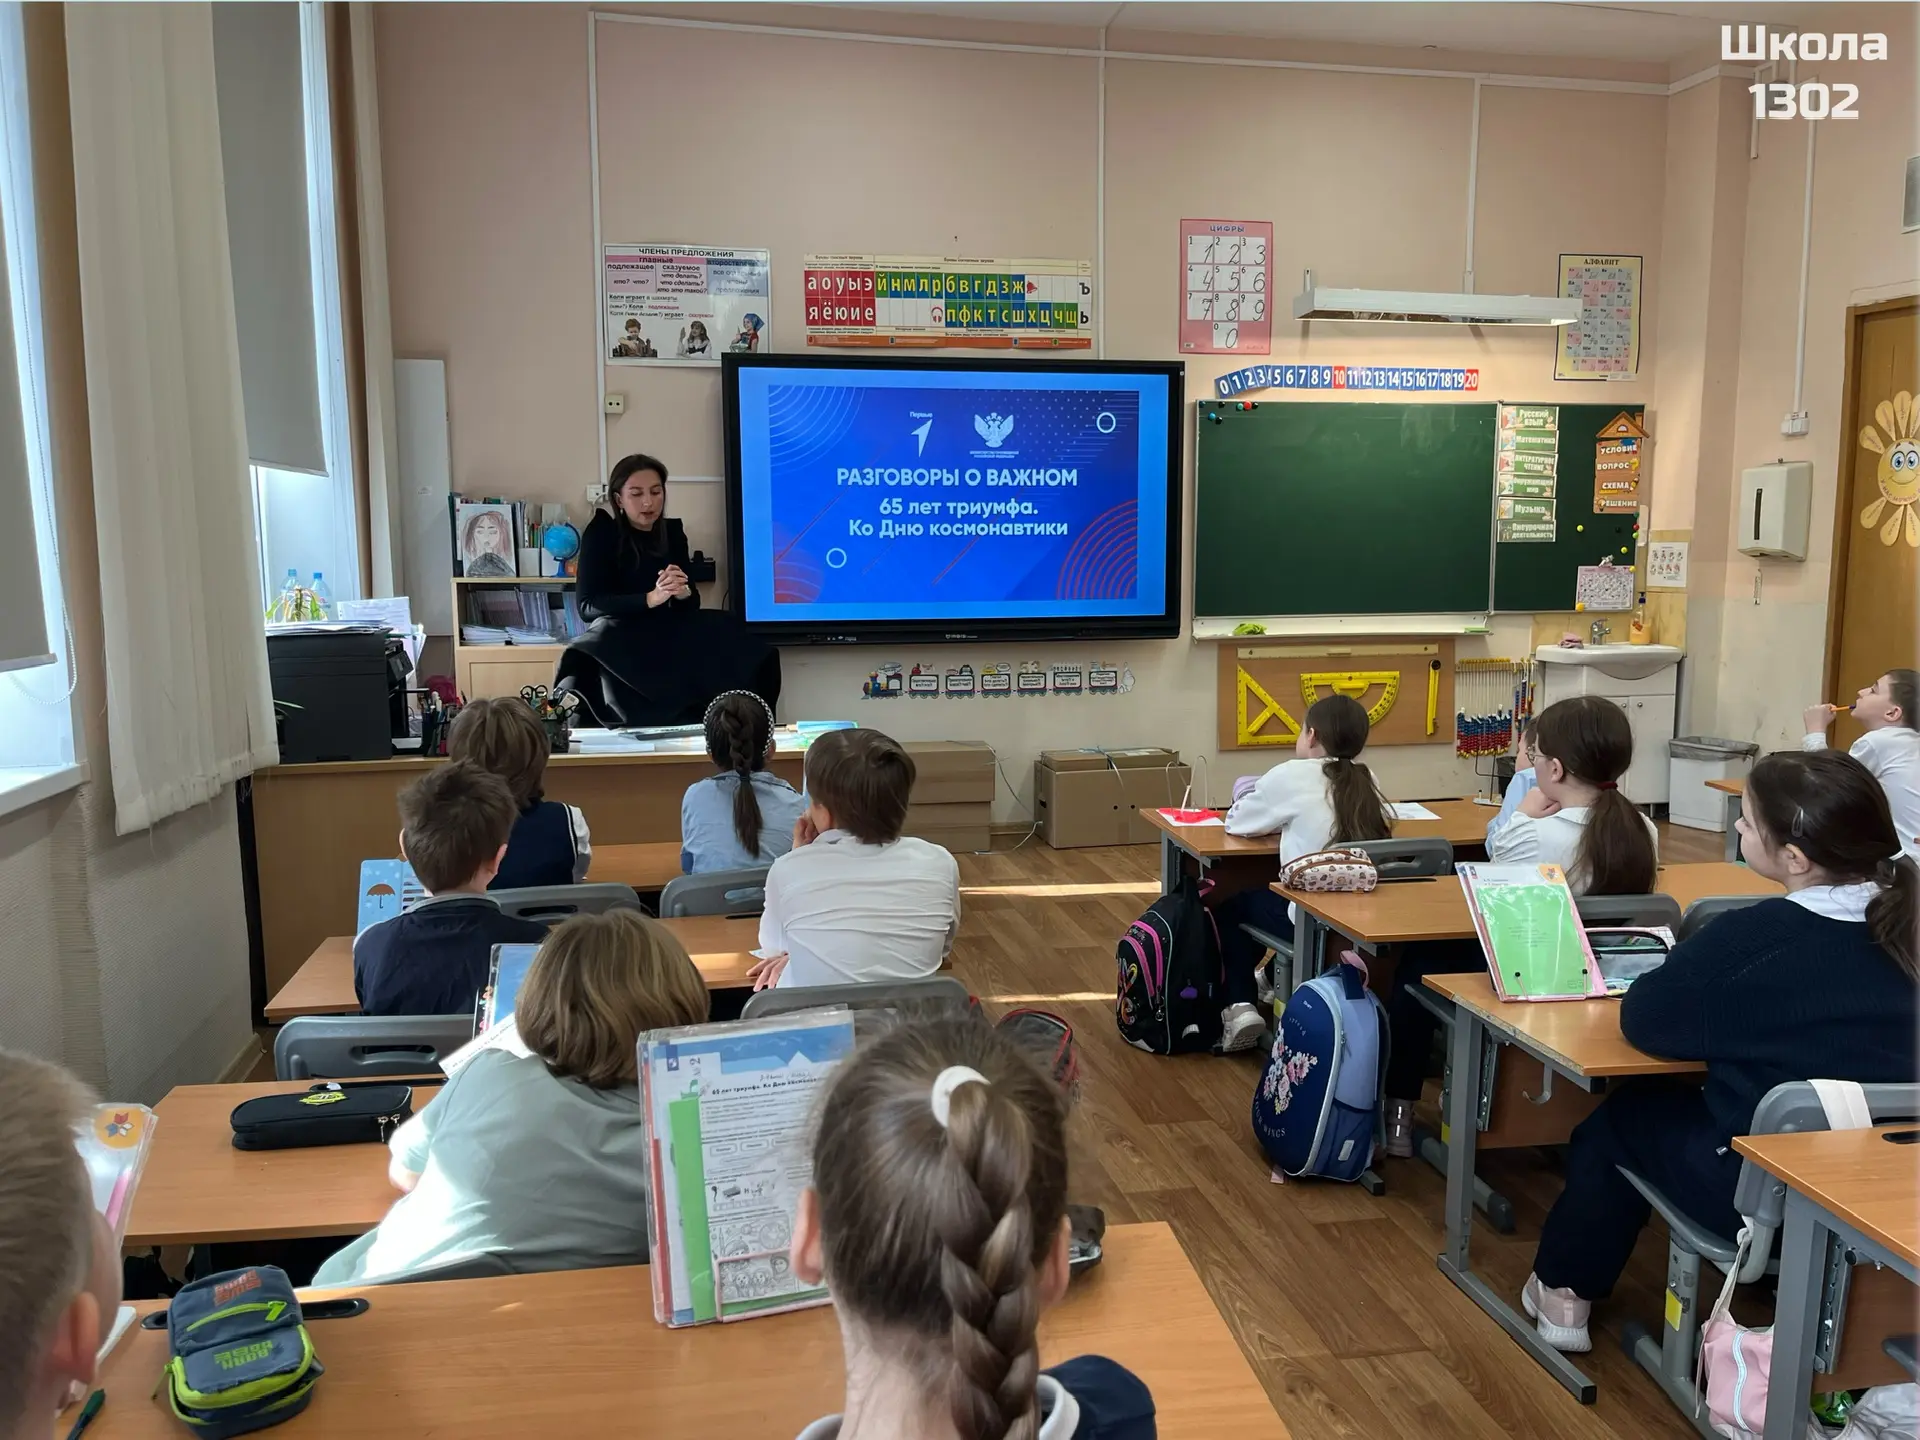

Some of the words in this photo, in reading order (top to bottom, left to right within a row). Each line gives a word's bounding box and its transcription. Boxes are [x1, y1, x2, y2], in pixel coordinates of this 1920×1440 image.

[671, 249, 734, 258] ПРЕДЛОЖЕНИЯ
[1204, 243, 1213, 263] 1
[1229, 244, 1240, 264] 2
[1254, 245, 1266, 264] 3
[1583, 258, 1620, 266] АЛФАВИТ
[662, 264, 700, 272] сказуемое
[1203, 271, 1213, 291] 4
[1228, 272, 1240, 291] 5
[1253, 272, 1265, 292] 6
[1202, 298, 1213, 320] 7
[1226, 299, 1239, 321] 8
[1253, 299, 1265, 321] 9
[1226, 328, 1238, 348] 0
[1220, 380, 1229, 394] 0
[1232, 375, 1241, 389] 1
[1244, 371, 1255, 386] 2
[1257, 369, 1266, 384] 3
[1274, 369, 1281, 384] 5
[1286, 369, 1294, 385] 6
[1299, 369, 1306, 384] 7
[1311, 369, 1318, 385] 8
[1323, 369, 1331, 385] 9
[1334, 370, 1345, 385] 10
[1348, 370, 1358, 386] 11
[1361, 370, 1372, 386] 12
[1374, 370, 1385, 386] 13
[1387, 370, 1399, 386] 14
[1401, 371, 1413, 387] 15
[1415, 372, 1427, 387] 16
[1427, 372, 1439, 387] 17
[1440, 372, 1452, 387] 18
[1452, 372, 1465, 388] 19
[1466, 372, 1478, 388] 20
[909, 411, 933, 419] Первые
[1519, 409, 1549, 418] Русский
[1600, 445, 1637, 454] УСЛОВИЕ
[1597, 462, 1630, 470] ВОПРОС
[836, 468, 960, 487] РАЗГОВОРЫ
[965, 469, 981, 487] О
[987, 468, 1078, 487] ВАЖНОМ
[1602, 481, 1629, 489] СХЕМА
[1600, 499, 1637, 507] РЕШЕНИЕ
[879, 498, 903, 515] 65
[907, 501, 942, 515] лет
[946, 498, 1039, 519] триумфа.
[1514, 504, 1546, 514] Музыка
[849, 520, 874, 536] Ко
[879, 520, 925, 539] Дню
[929, 522, 1068, 537] космонавтики
